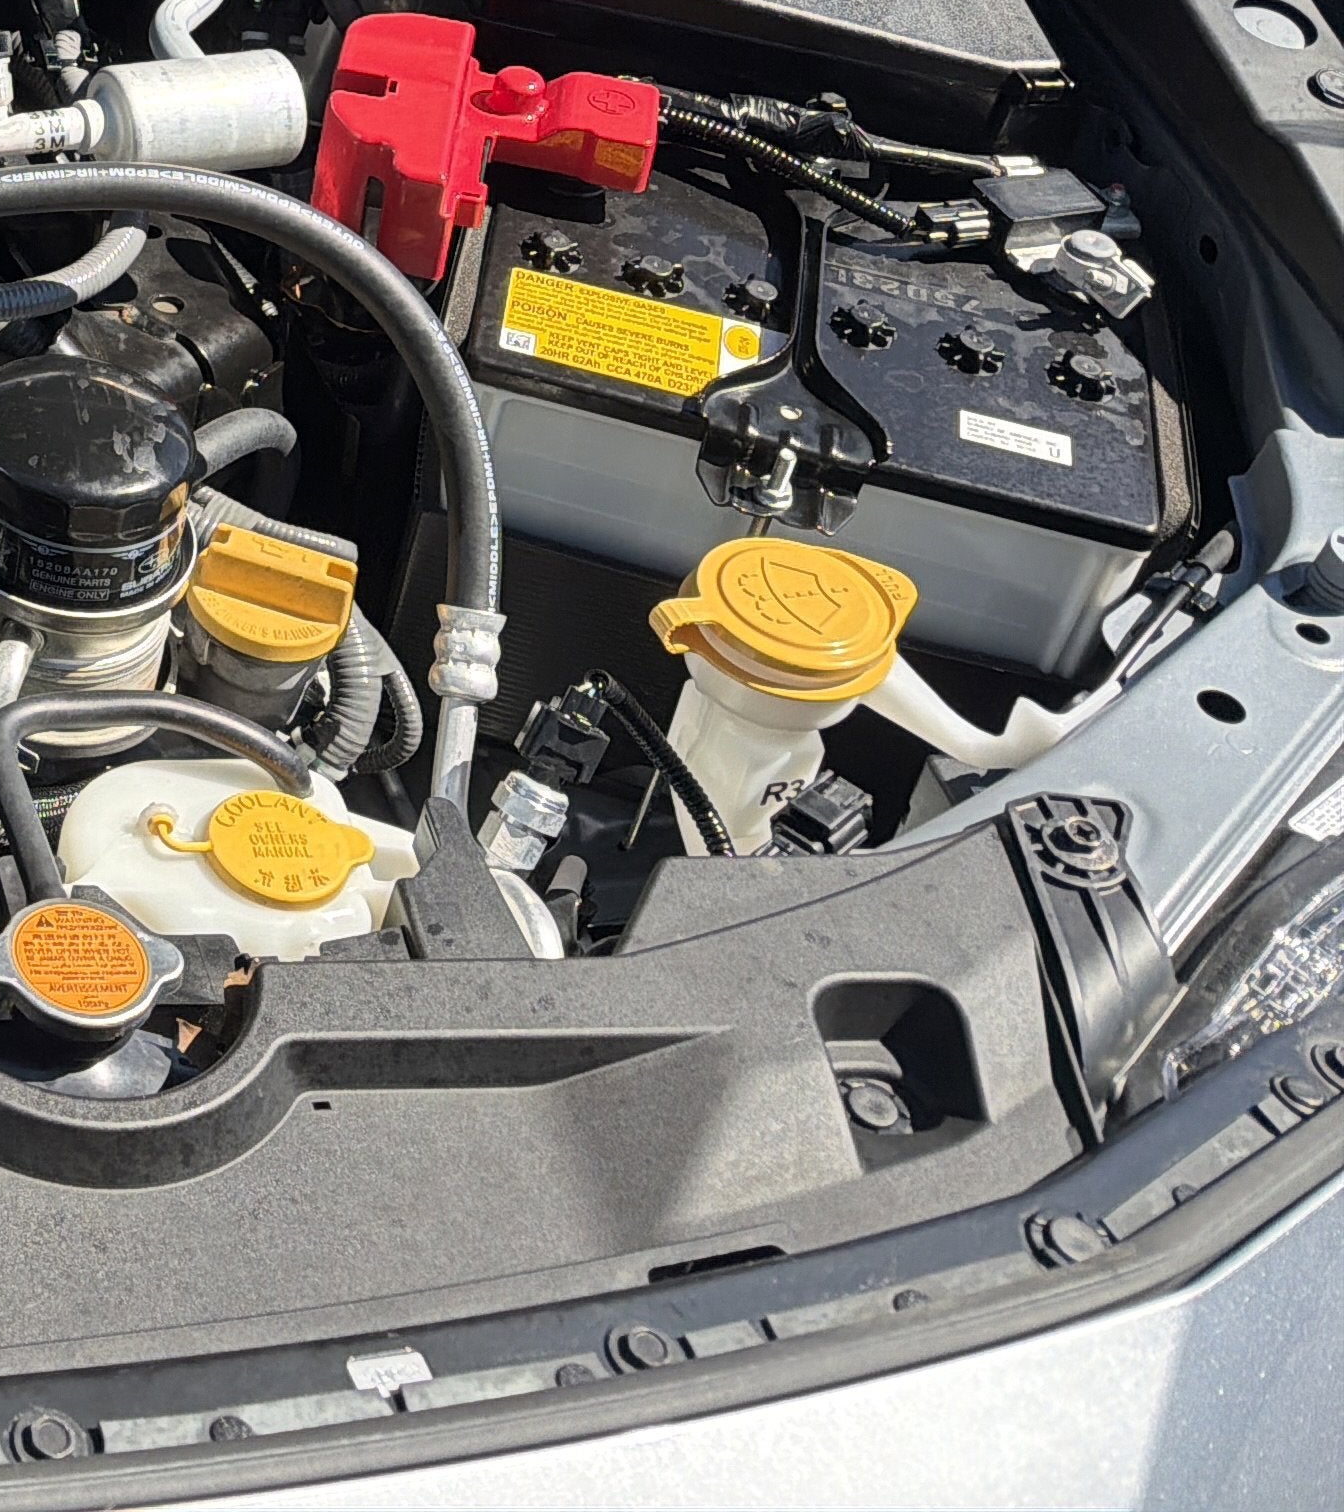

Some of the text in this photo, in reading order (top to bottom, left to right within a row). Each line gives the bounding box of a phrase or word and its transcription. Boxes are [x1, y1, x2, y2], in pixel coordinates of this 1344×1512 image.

[35, 135, 65, 150] 3M
[515, 270, 575, 292] DANGER
[578, 287, 632, 307] EXPLOSIVE
[830, 267, 983, 317] 75D23L
[511, 300, 568, 322] POISON
[575, 316, 614, 333] CAUSES
[616, 326, 654, 343] SEVERE
[655, 336, 690, 352] BURNS
[540, 347, 570, 363] 20HR
[606, 363, 632, 378] CCA
[634, 370, 663, 385] 470A
[547, 339, 575, 353] KEEP
[575, 346, 595, 359] OUT
[596, 351, 611, 363] OF
[612, 355, 647, 372] REACH
[548, 331, 574, 345] KEEP
[576, 338, 601, 351] VENT
[602, 344, 630, 358] CAPS
[631, 351, 660, 365] TIGHT
[661, 358, 683, 371] AND
[30, 557, 118, 577] 15208AA170
[32, 569, 111, 587] GENUINE PARTS
[32, 581, 106, 599] ENGINE ONLY
